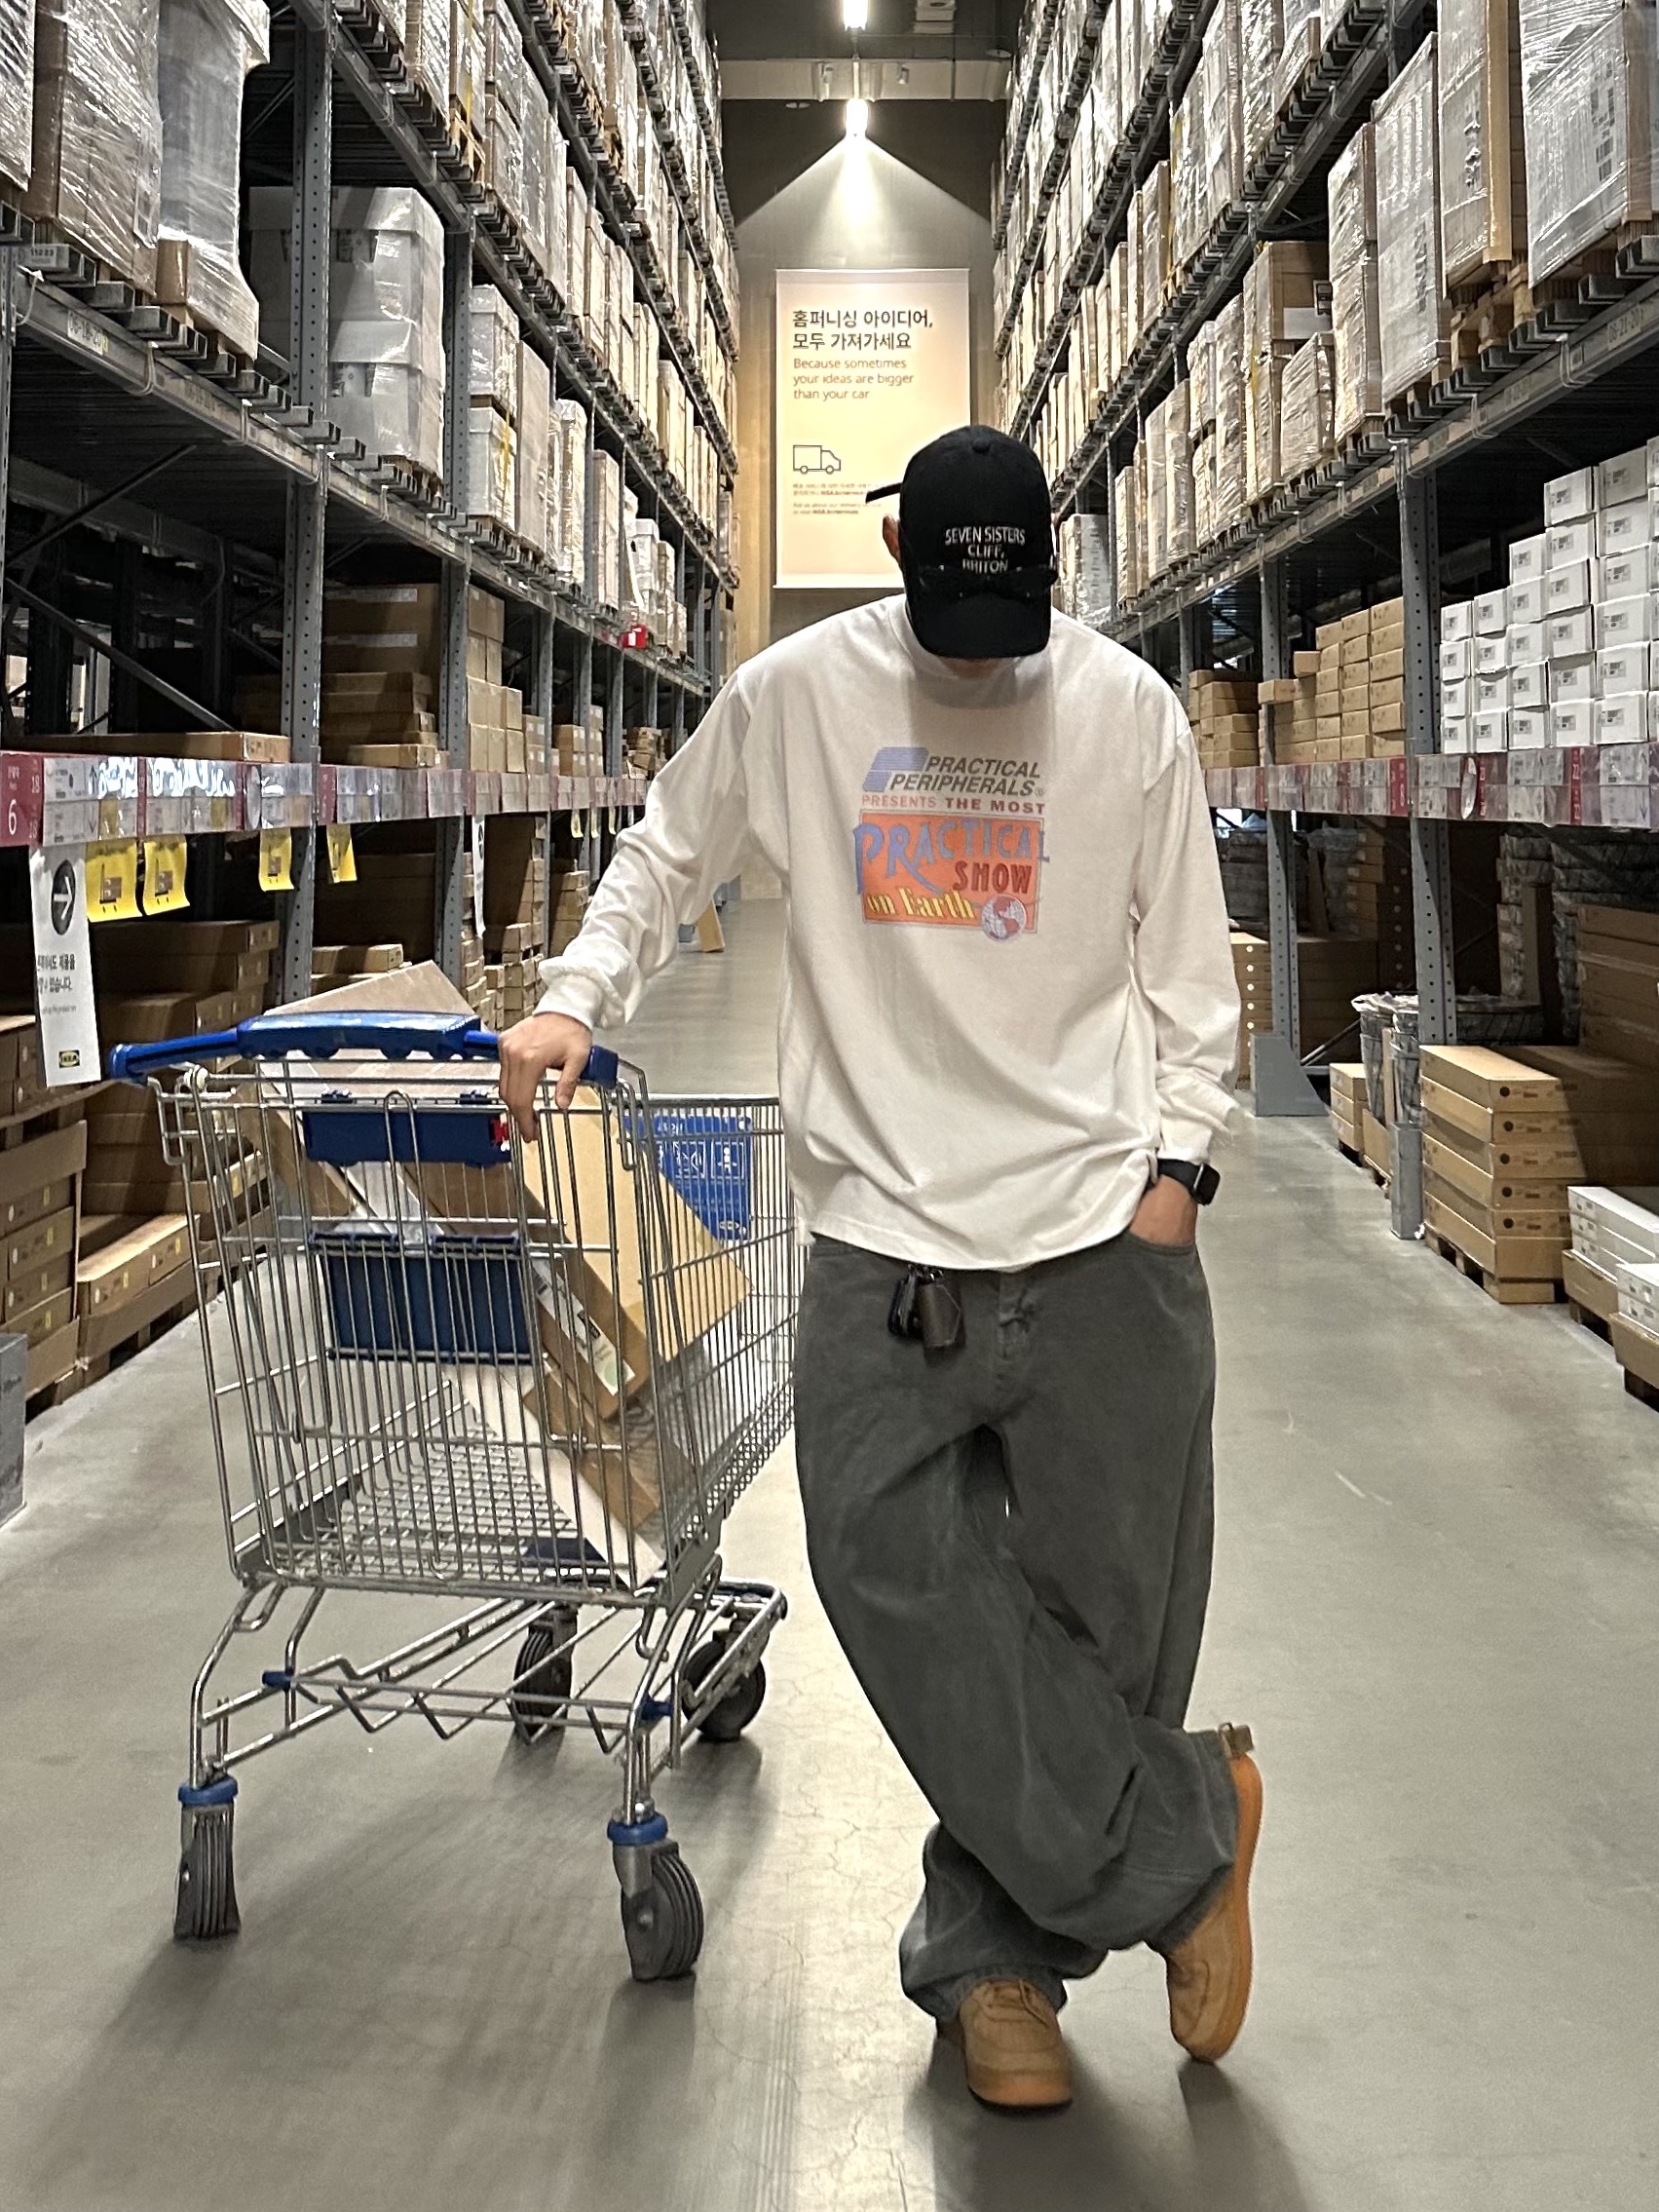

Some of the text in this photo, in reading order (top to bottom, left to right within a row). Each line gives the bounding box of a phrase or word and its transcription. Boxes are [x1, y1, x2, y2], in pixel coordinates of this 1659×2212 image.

[792, 309, 933, 328] 홈퍼니싱 아이디어,
[792, 332, 912, 351] 모두 가져가세요
[793, 358, 907, 369] Because sometimes
[793, 373, 914, 387] your ideas are bigger
[793, 389, 870, 401] than your car
[944, 526, 1026, 546] SEVEN SISTERS
[925, 755, 1040, 779] PRACTICAL
[862, 794, 1045, 815] PRESENTS THE MOST
[8, 799, 17, 835] 6
[852, 820, 1050, 896] PRACTICAL
[952, 860, 1033, 895] SHOW
[866, 886, 978, 920] on Earth
